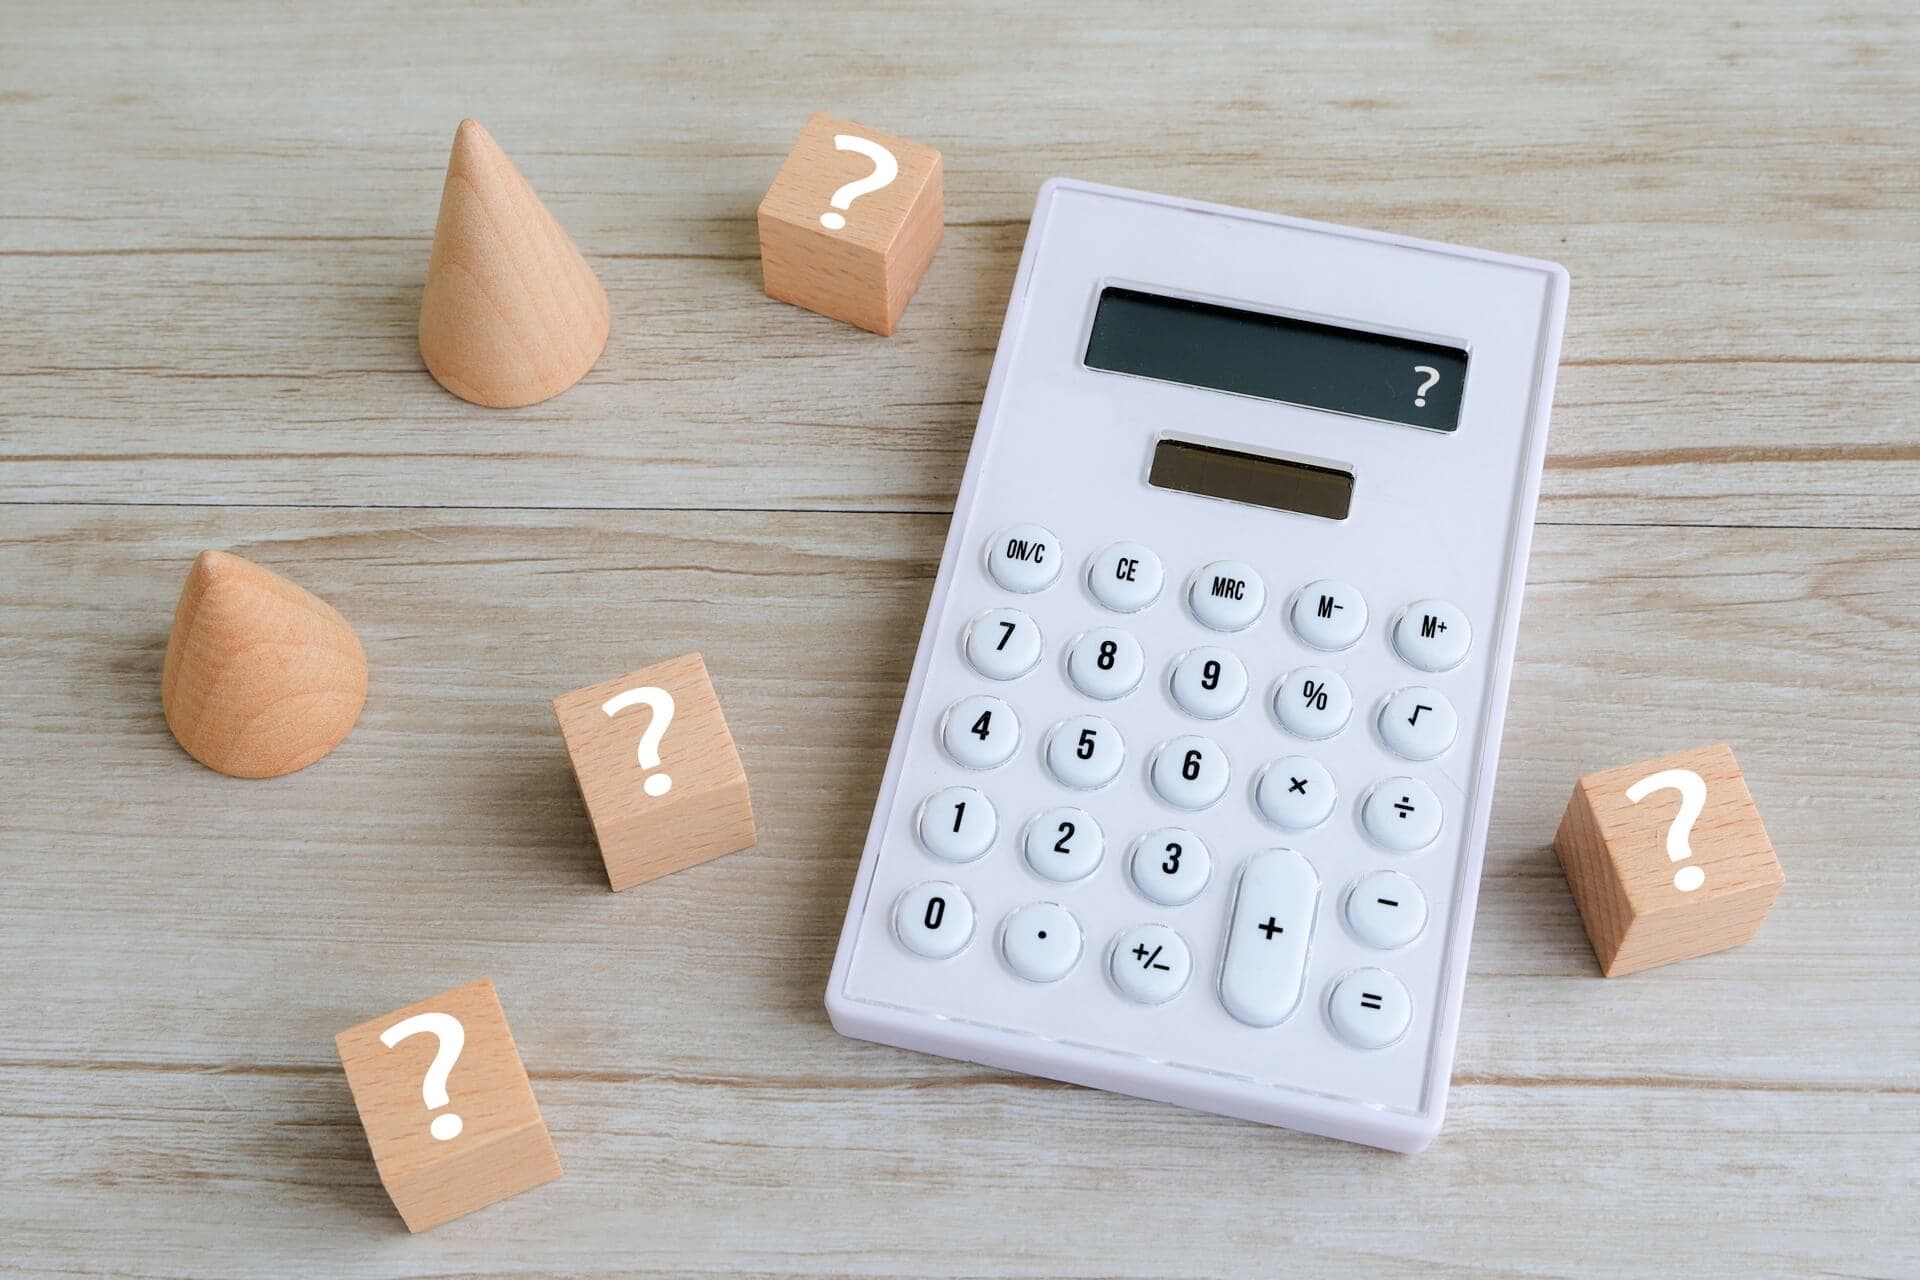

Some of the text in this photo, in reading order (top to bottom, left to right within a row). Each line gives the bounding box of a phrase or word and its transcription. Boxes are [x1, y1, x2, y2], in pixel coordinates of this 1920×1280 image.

[820, 134, 899, 230] ?
[1414, 365, 1441, 408] ?
[1006, 538, 1046, 564] ON/C
[1116, 557, 1139, 582] CE
[1211, 576, 1246, 601] MRC
[996, 621, 1016, 651] 7
[1421, 614, 1448, 639] M+
[1097, 640, 1118, 671] 8
[1201, 660, 1221, 691] 9
[1302, 680, 1328, 711] %
[971, 710, 992, 741] 4
[601, 686, 675, 797] ?
[1076, 728, 1097, 760] 5
[1182, 749, 1202, 781] 6
[953, 802, 966, 833] 1
[1626, 768, 1708, 892] ?
[1053, 821, 1075, 854] 2
[1162, 842, 1182, 875] 3
[924, 896, 946, 930] 0
[1258, 916, 1284, 940] +
[1360, 992, 1383, 1010] =
[379, 1012, 466, 1141] ?
